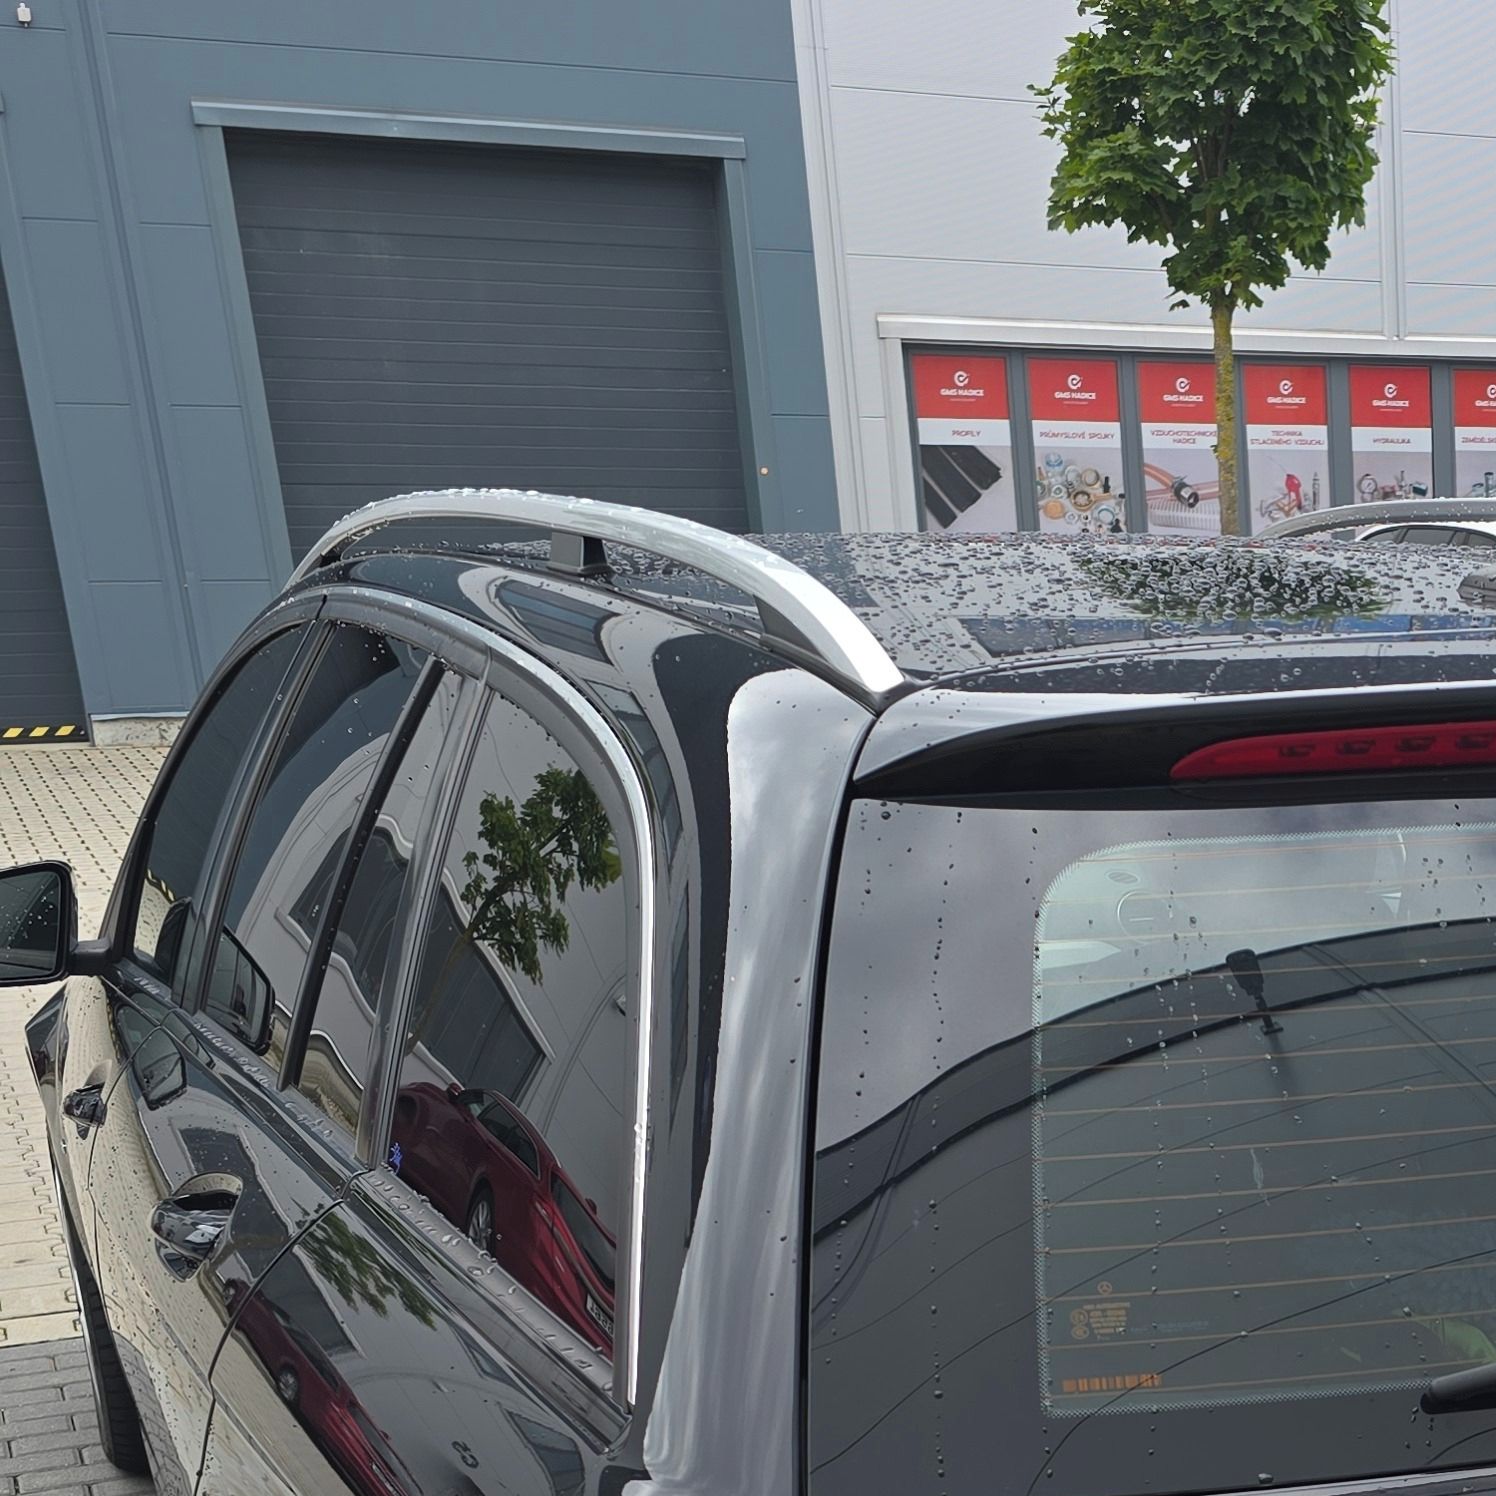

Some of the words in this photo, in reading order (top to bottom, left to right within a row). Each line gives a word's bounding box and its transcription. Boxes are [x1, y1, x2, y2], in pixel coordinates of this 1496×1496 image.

[940, 388, 957, 396] GMS
[958, 388, 984, 396] HADICE
[1054, 391, 1070, 400] GMS
[1071, 391, 1096, 400] HADICE
[1163, 394, 1179, 402] GMS
[1180, 394, 1203, 402] HADICE
[951, 429, 981, 438] PROFILY
[1088, 432, 1115, 440] SPOJKY
